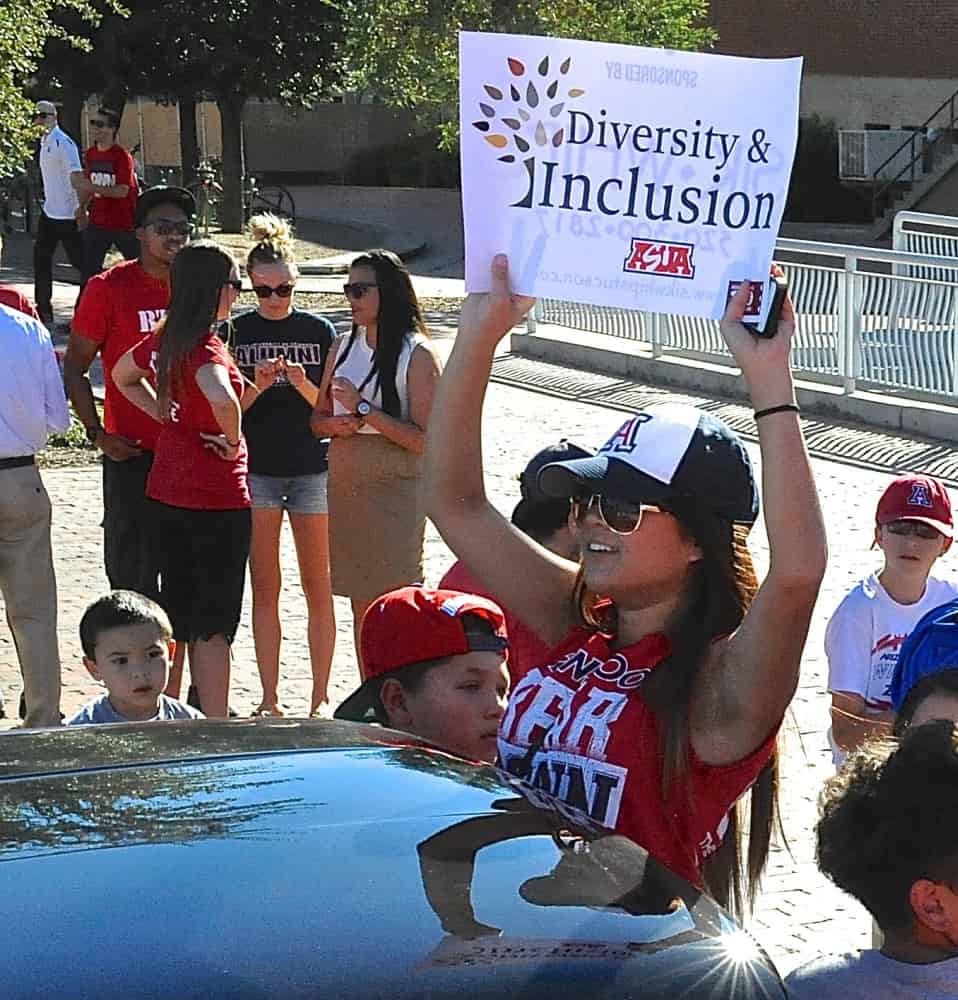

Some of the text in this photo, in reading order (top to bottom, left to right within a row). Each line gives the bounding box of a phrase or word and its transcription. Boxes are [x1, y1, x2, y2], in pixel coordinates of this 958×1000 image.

[567, 109, 772, 170] Diversity &
[538, 161, 776, 230] Inclusion
[626, 241, 693, 277] ASUA
[599, 413, 653, 453] A
[907, 484, 933, 508] A
